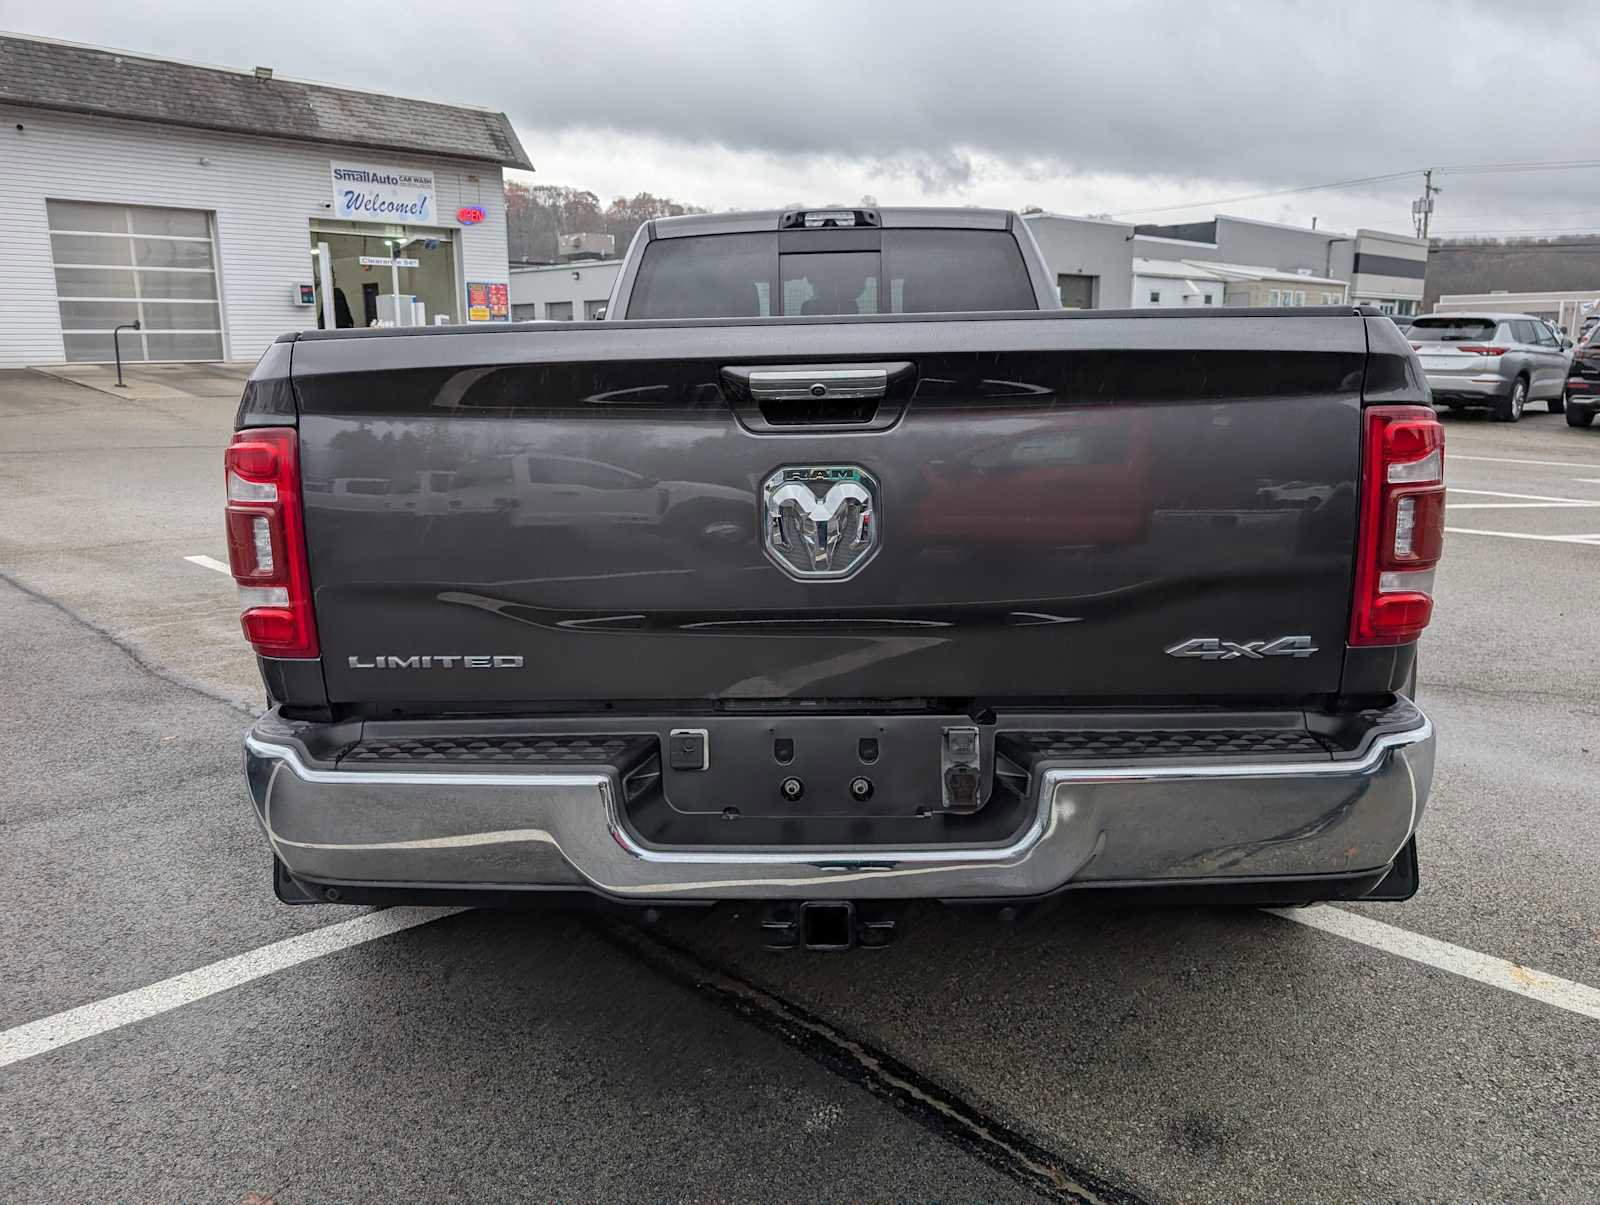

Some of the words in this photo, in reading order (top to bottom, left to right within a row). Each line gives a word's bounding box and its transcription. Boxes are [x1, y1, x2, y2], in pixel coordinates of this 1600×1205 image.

[399, 174, 412, 183] CAR
[413, 177, 432, 185] WASH
[344, 190, 427, 215] Welcome!
[458, 207, 484, 222] OPEN
[361, 256, 401, 266] Clearane
[783, 468, 856, 481] RAM
[348, 655, 524, 669] LIMITED
